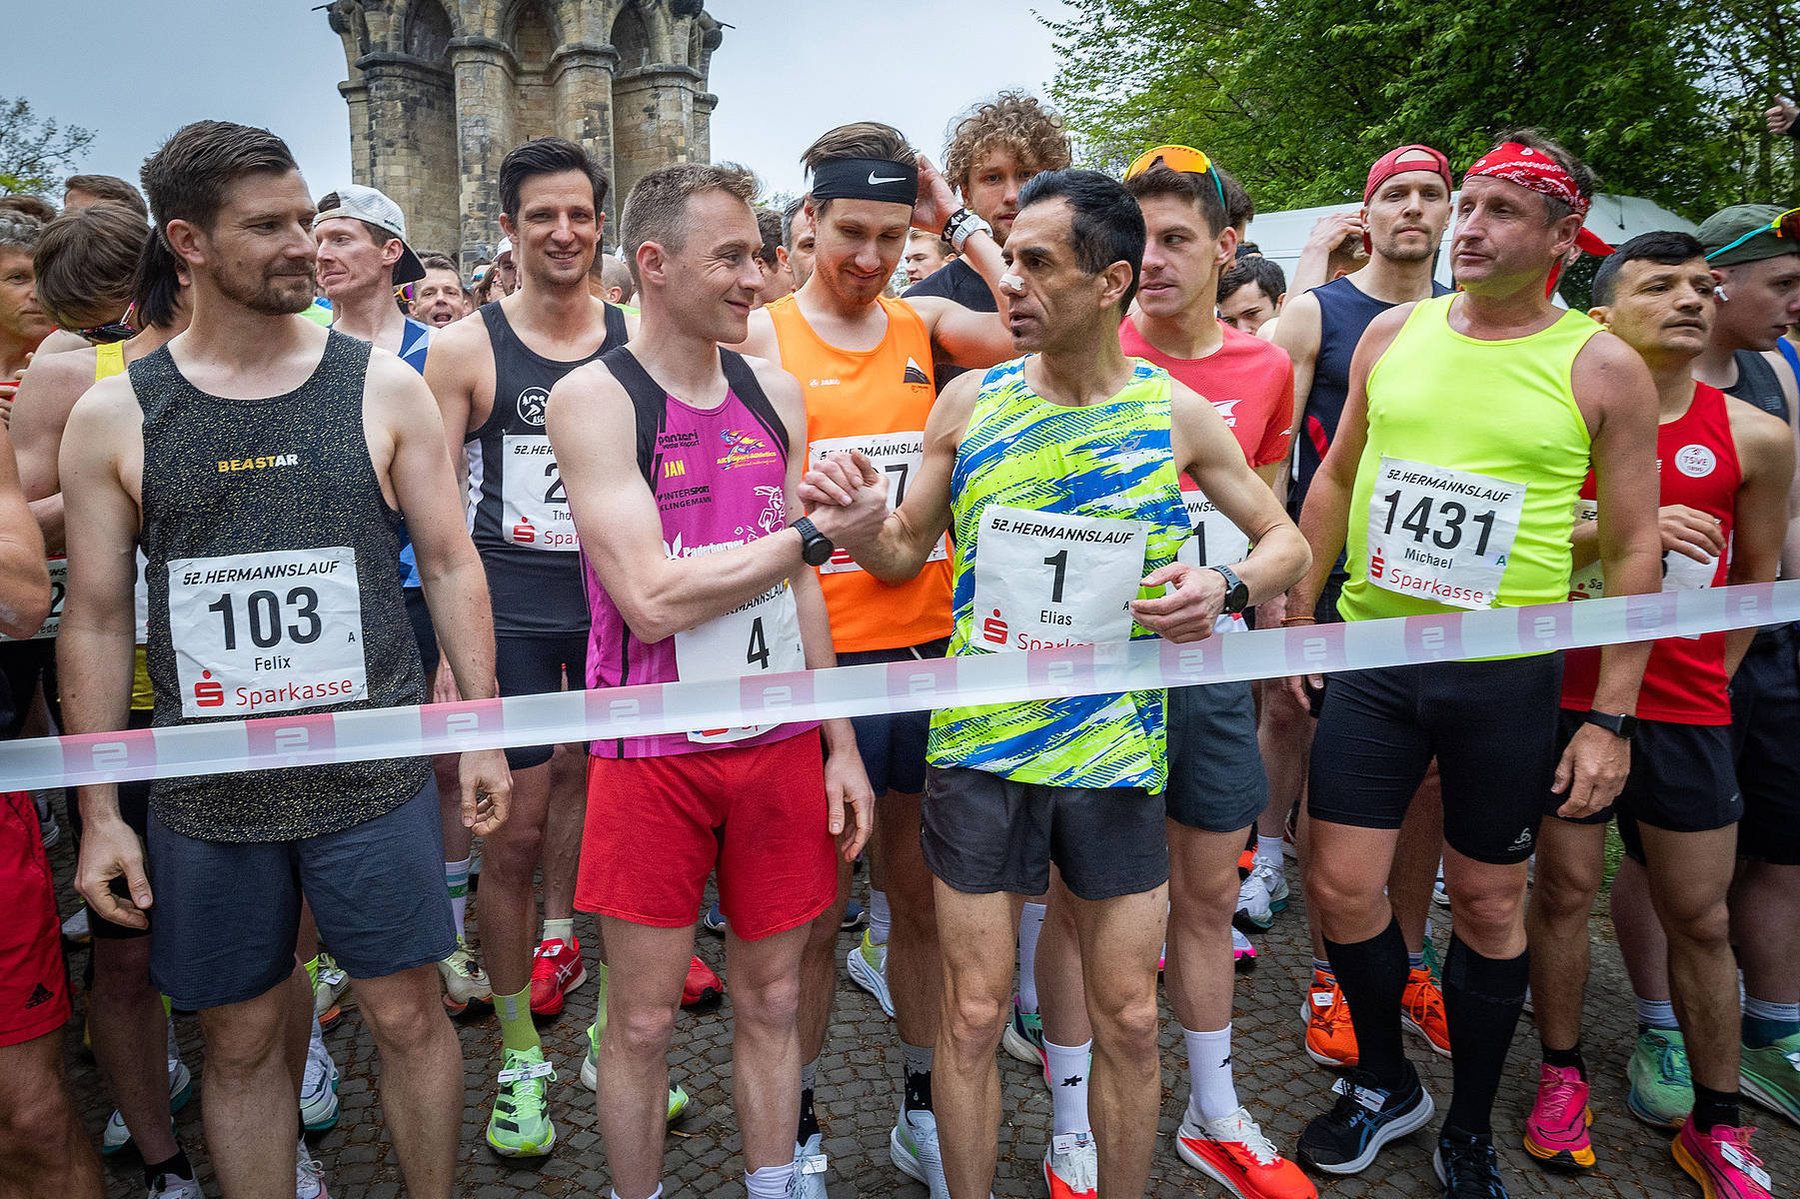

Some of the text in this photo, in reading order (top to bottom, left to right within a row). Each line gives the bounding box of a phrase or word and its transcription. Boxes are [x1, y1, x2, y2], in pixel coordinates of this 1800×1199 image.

[217, 454, 300, 472] BEASTAR
[664, 459, 686, 479] JAN
[1384, 489, 1497, 557] 1431
[1404, 547, 1454, 570] Michael
[1496, 554, 1508, 567] A
[1043, 550, 1069, 604] 1
[1389, 568, 1485, 604] Sparkasse
[1122, 600, 1130, 611] A
[208, 585, 322, 651] 103
[1040, 609, 1073, 627] Elias
[347, 631, 356, 643] A
[746, 616, 770, 670] 4
[254, 655, 291, 672] Felix
[235, 679, 353, 710] Sparkasse
